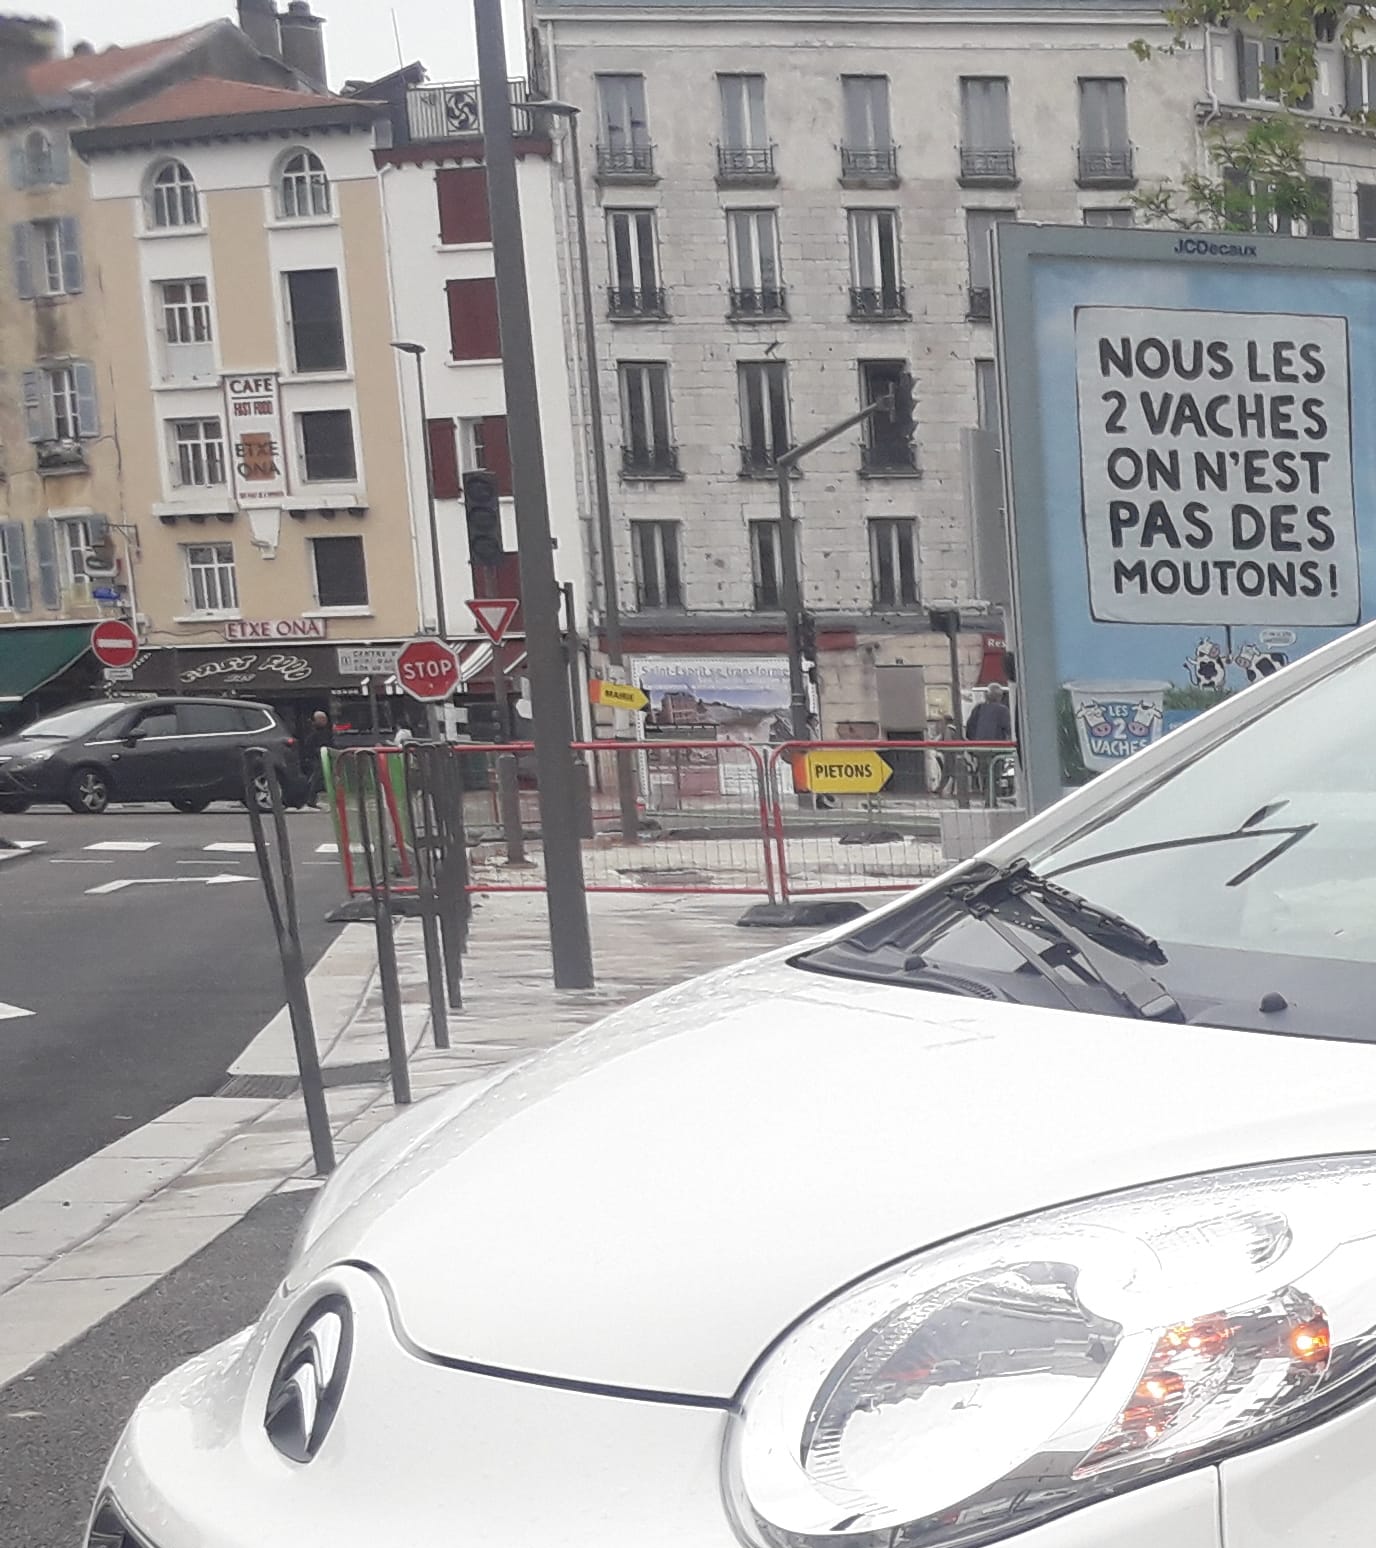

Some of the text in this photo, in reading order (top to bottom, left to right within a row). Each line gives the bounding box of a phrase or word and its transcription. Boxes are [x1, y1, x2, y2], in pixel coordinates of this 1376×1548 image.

[1174, 239, 1257, 257] JCDecaux
[1099, 336, 1326, 383] NOUS LES
[1102, 390, 1328, 440] 2 VACHES
[235, 441, 279, 457] ETXE
[237, 461, 281, 479] ONA
[1107, 447, 1331, 494] ON N'EST
[1109, 500, 1335, 551] PAS DES
[227, 620, 321, 637] ETXE ONA
[403, 660, 452, 680] STOP
[1109, 704, 1129, 717] LES
[1112, 717, 1128, 739] 2
[815, 764, 872, 778] PIETONS
